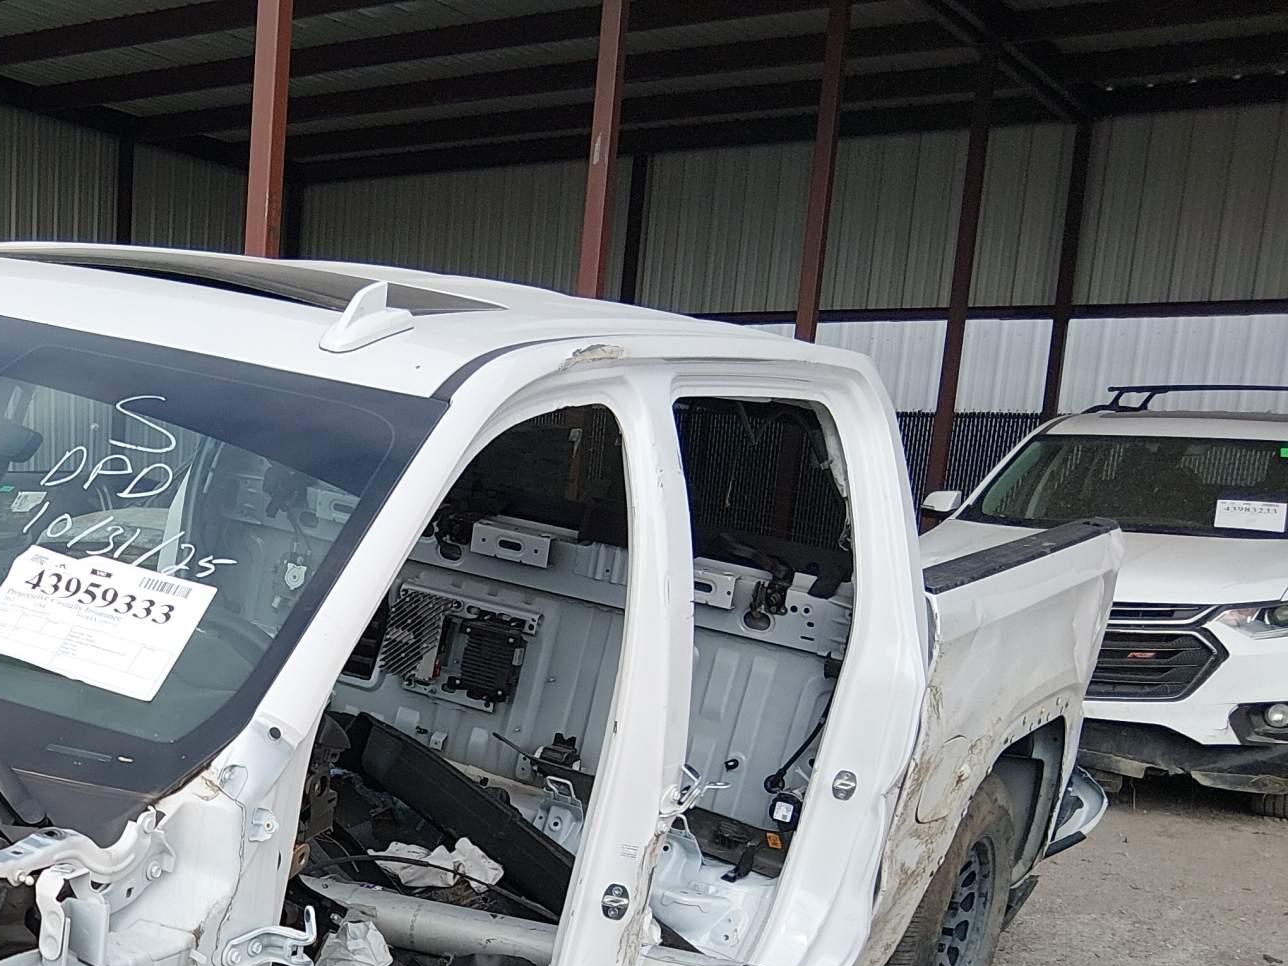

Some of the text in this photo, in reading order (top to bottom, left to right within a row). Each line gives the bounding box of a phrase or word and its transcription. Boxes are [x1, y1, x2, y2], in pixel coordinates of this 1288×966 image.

[109, 394, 177, 453] S
[39, 445, 174, 498] DPD
[22, 500, 239, 578] 10/31/25
[24, 569, 175, 625] 43959333
